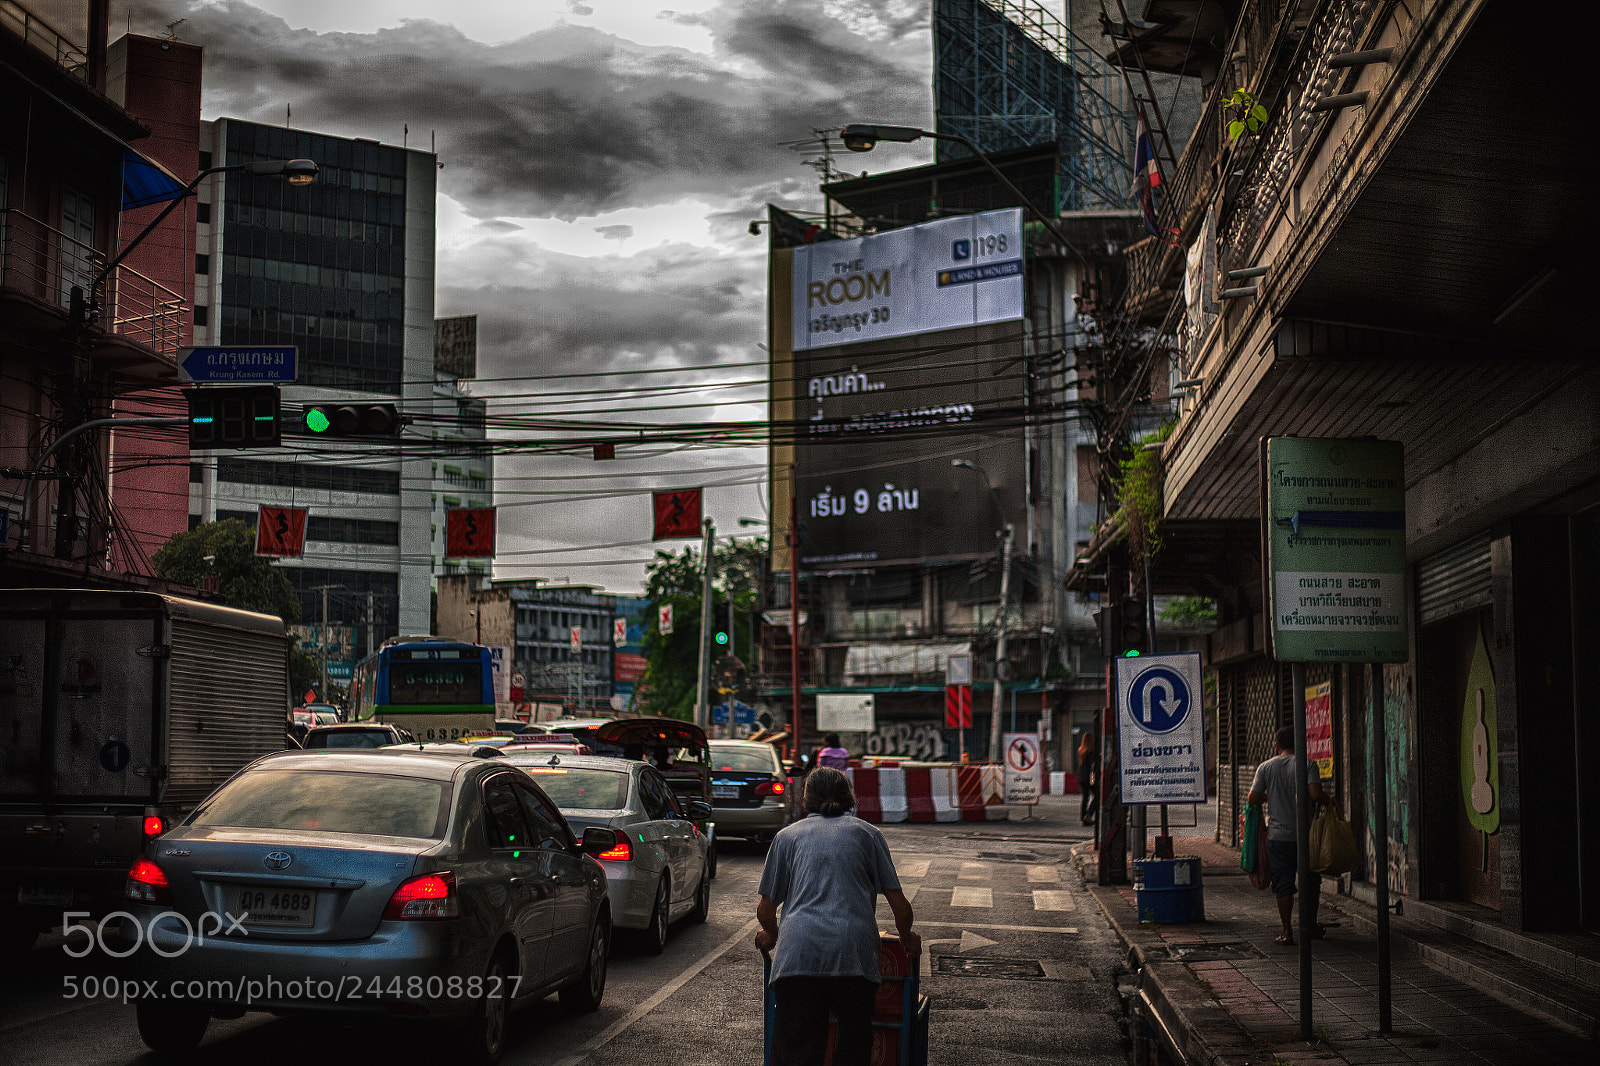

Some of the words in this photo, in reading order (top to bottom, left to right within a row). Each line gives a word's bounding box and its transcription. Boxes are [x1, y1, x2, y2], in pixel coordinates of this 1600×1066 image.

[972, 233, 1008, 258] 1198
[833, 258, 864, 274] THE
[808, 269, 891, 309] ROOM
[809, 311, 869, 333] เจริญกรุง
[871, 306, 891, 325] 30
[207, 352, 284, 370] ถ.กรุงเกษม
[210, 371, 234, 380] Krung
[236, 371, 264, 379] Kasem
[811, 484, 847, 519] เริ่ม
[853, 488, 870, 514] 9
[877, 482, 920, 513] ล้าน
[1299, 577, 1342, 589] ถนนสวย
[1348, 577, 1381, 589] สะอาด
[1299, 592, 1382, 607] บาทวิถีเรียบสบาย
[1281, 608, 1399, 626] เครื่องหมายจราจรชัดเจน
[109, 746, 119, 767] 1
[1131, 743, 1192, 757] ช่องขวา
[271, 893, 311, 911] 4689
